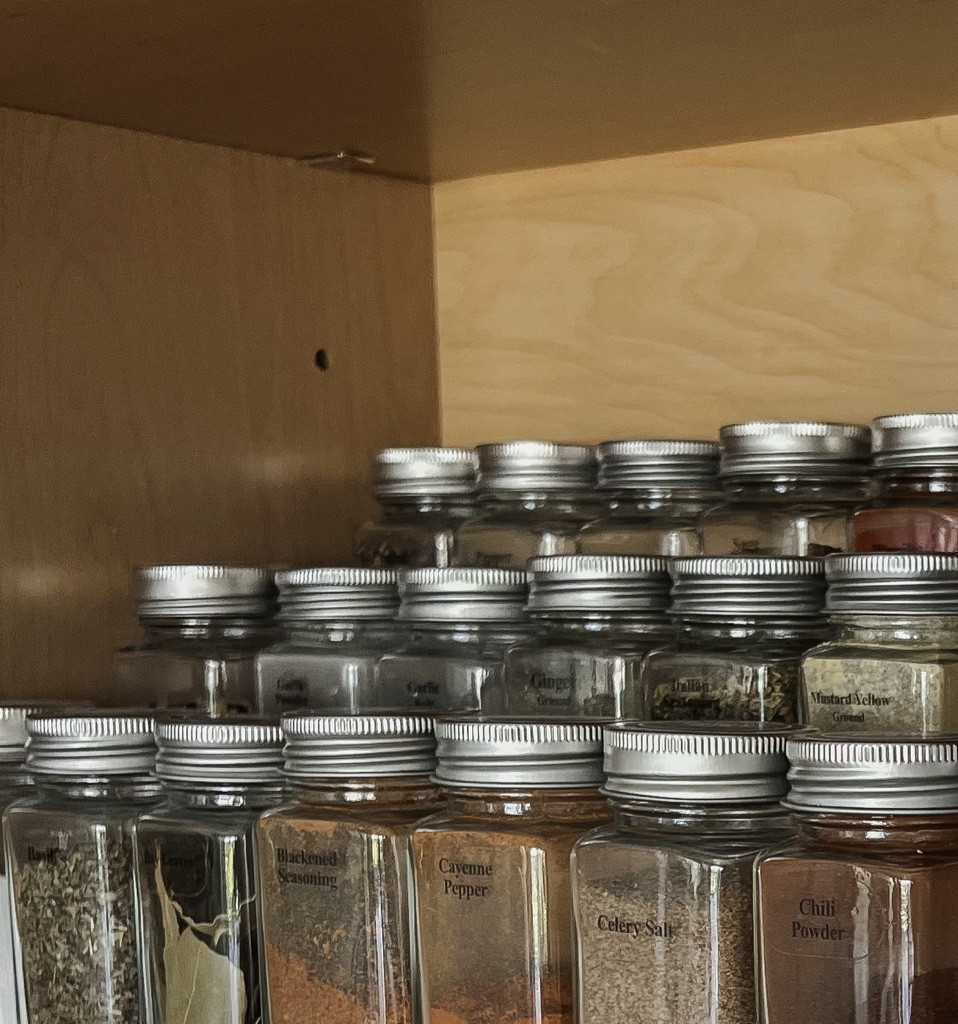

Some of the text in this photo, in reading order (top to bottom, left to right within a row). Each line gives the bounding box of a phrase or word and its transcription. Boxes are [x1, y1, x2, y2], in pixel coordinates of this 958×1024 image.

[811, 691, 892, 706] Mustard Yellow
[277, 848, 338, 866] Blackened
[439, 858, 493, 878] Cayenne
[278, 869, 338, 890] Seasoning
[444, 879, 488, 899] Pepper
[800, 898, 836, 917] Chili
[598, 915, 674, 939] Celery Salt
[792, 921, 847, 941] Powder
